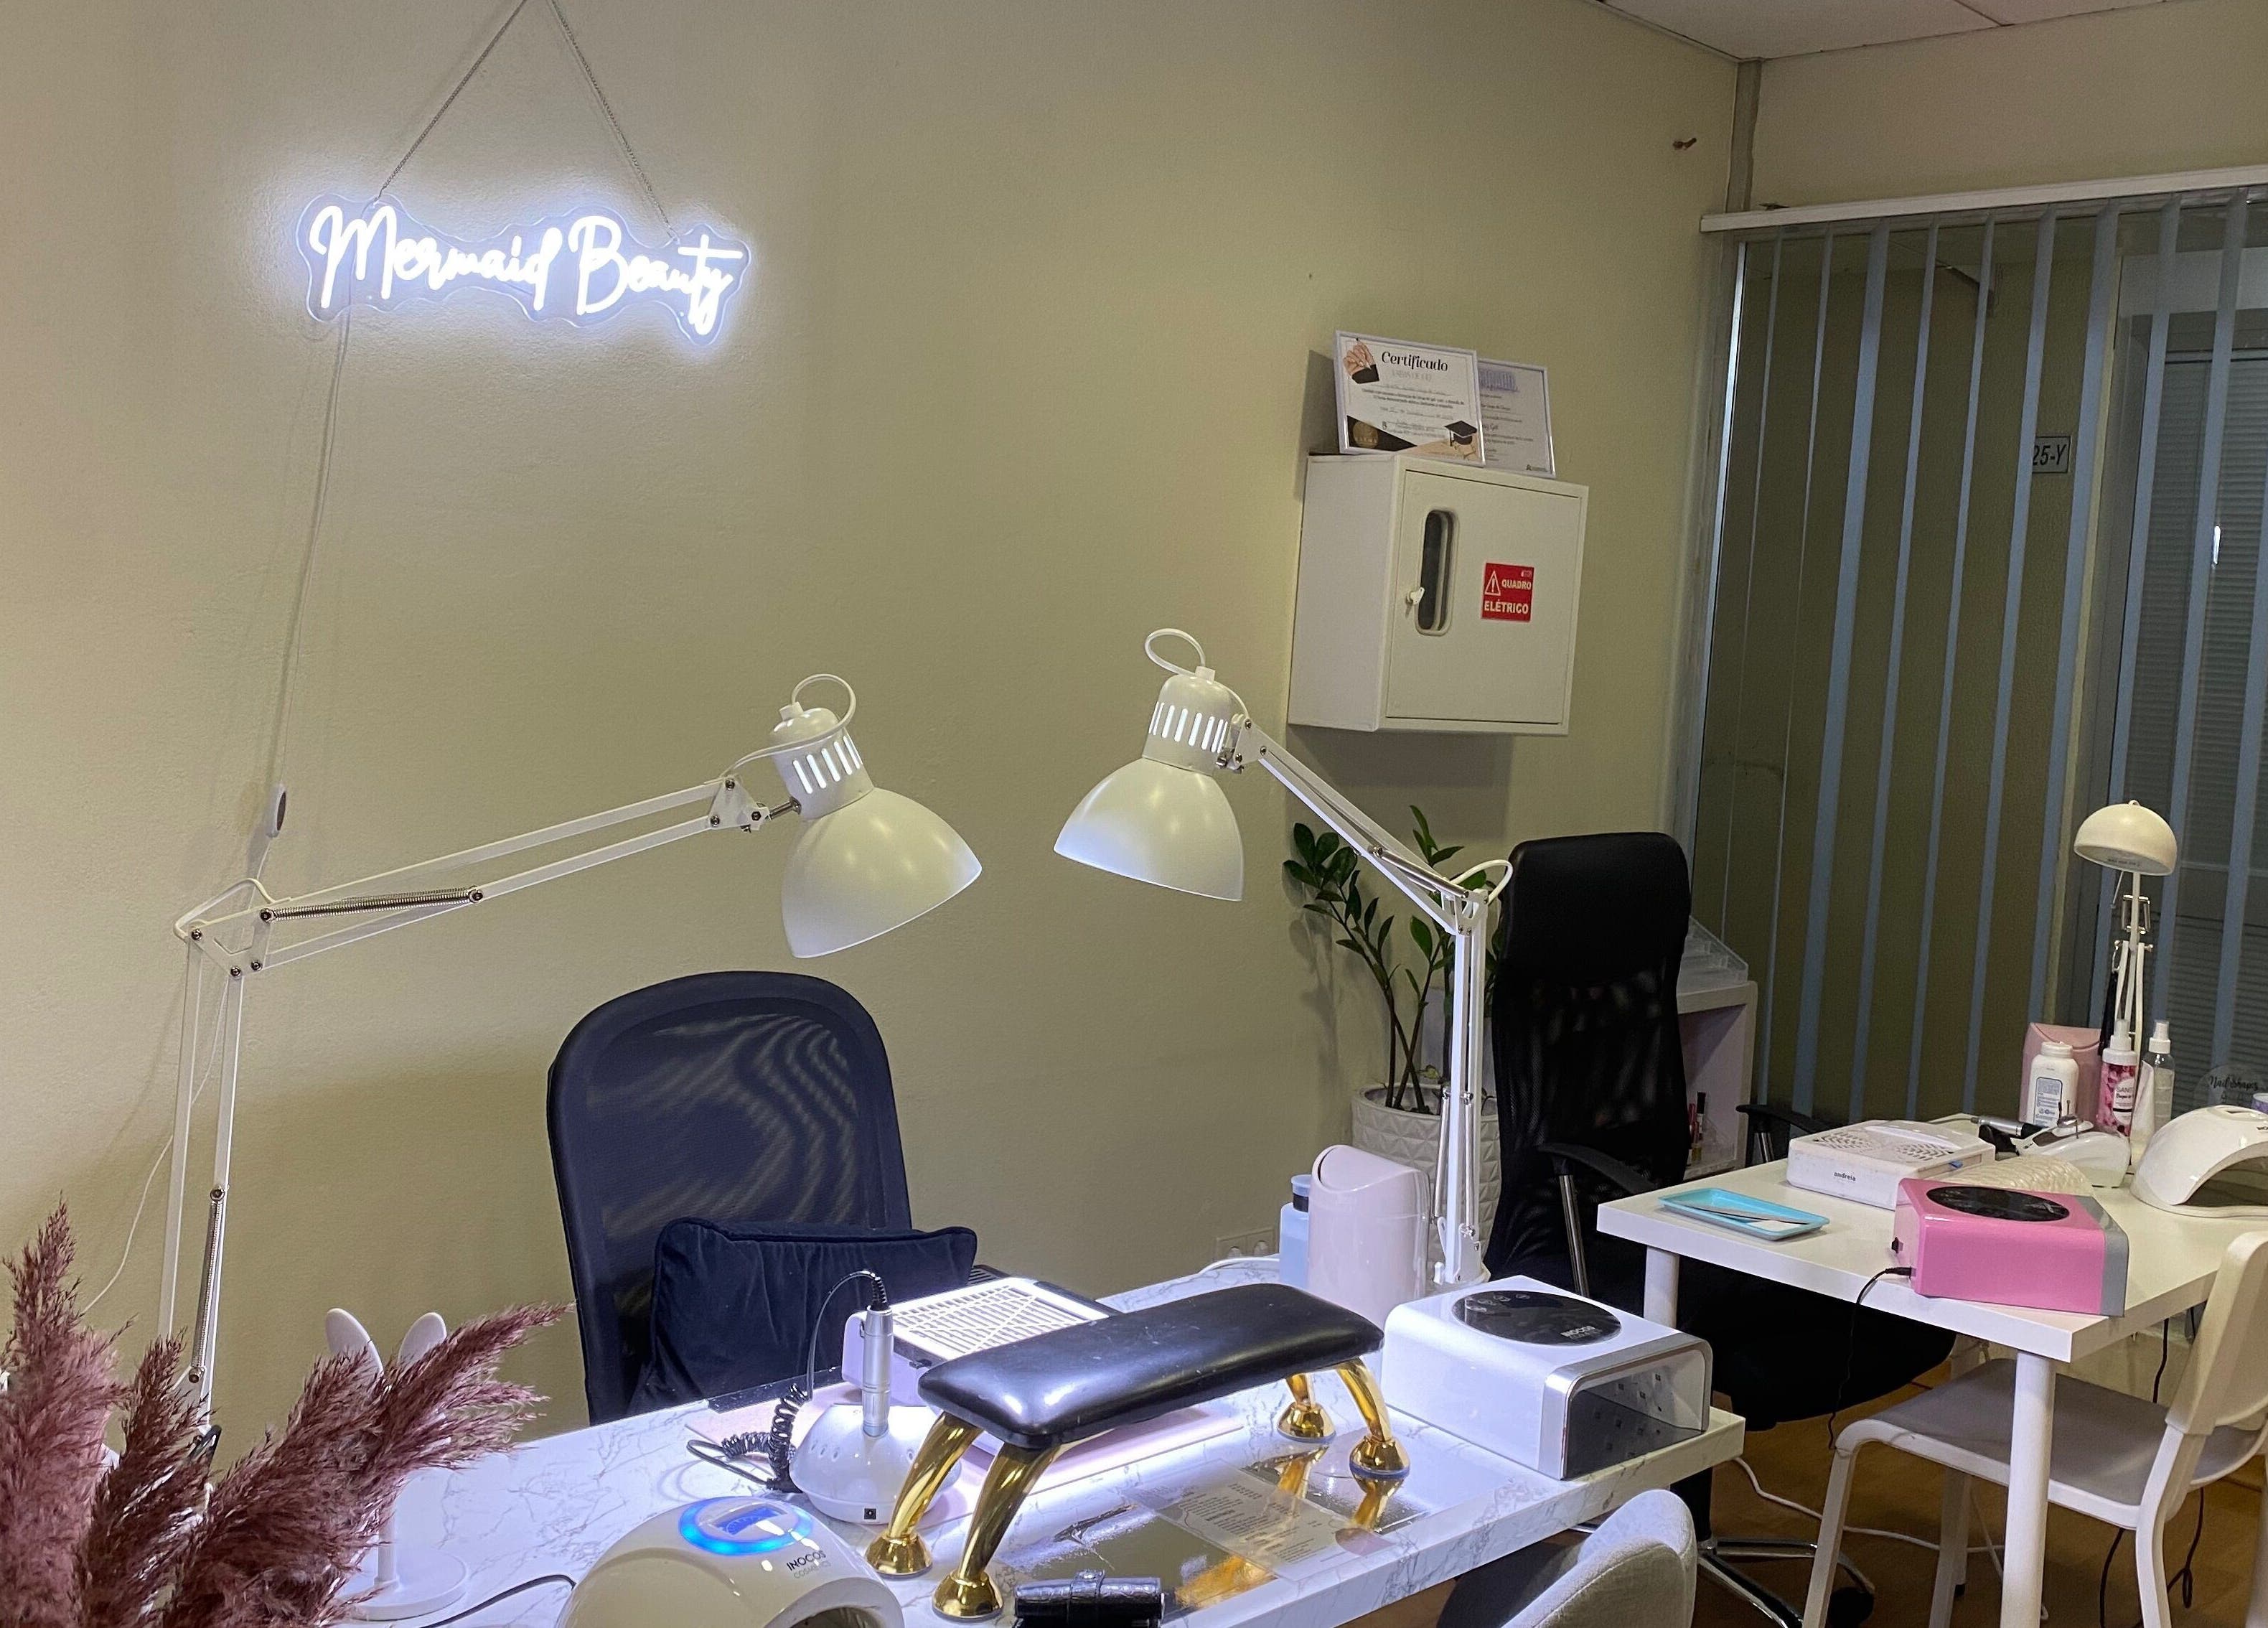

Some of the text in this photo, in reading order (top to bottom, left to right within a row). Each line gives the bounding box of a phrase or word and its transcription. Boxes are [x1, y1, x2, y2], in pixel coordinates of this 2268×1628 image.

[309, 205, 744, 335] Mermaid Beauty
[1381, 351, 1448, 372] Certificado
[1501, 579, 1532, 590] QUADRO
[1484, 599, 1529, 614] ELÉTRICO
[786, 1550, 827, 1571] INOCOS
